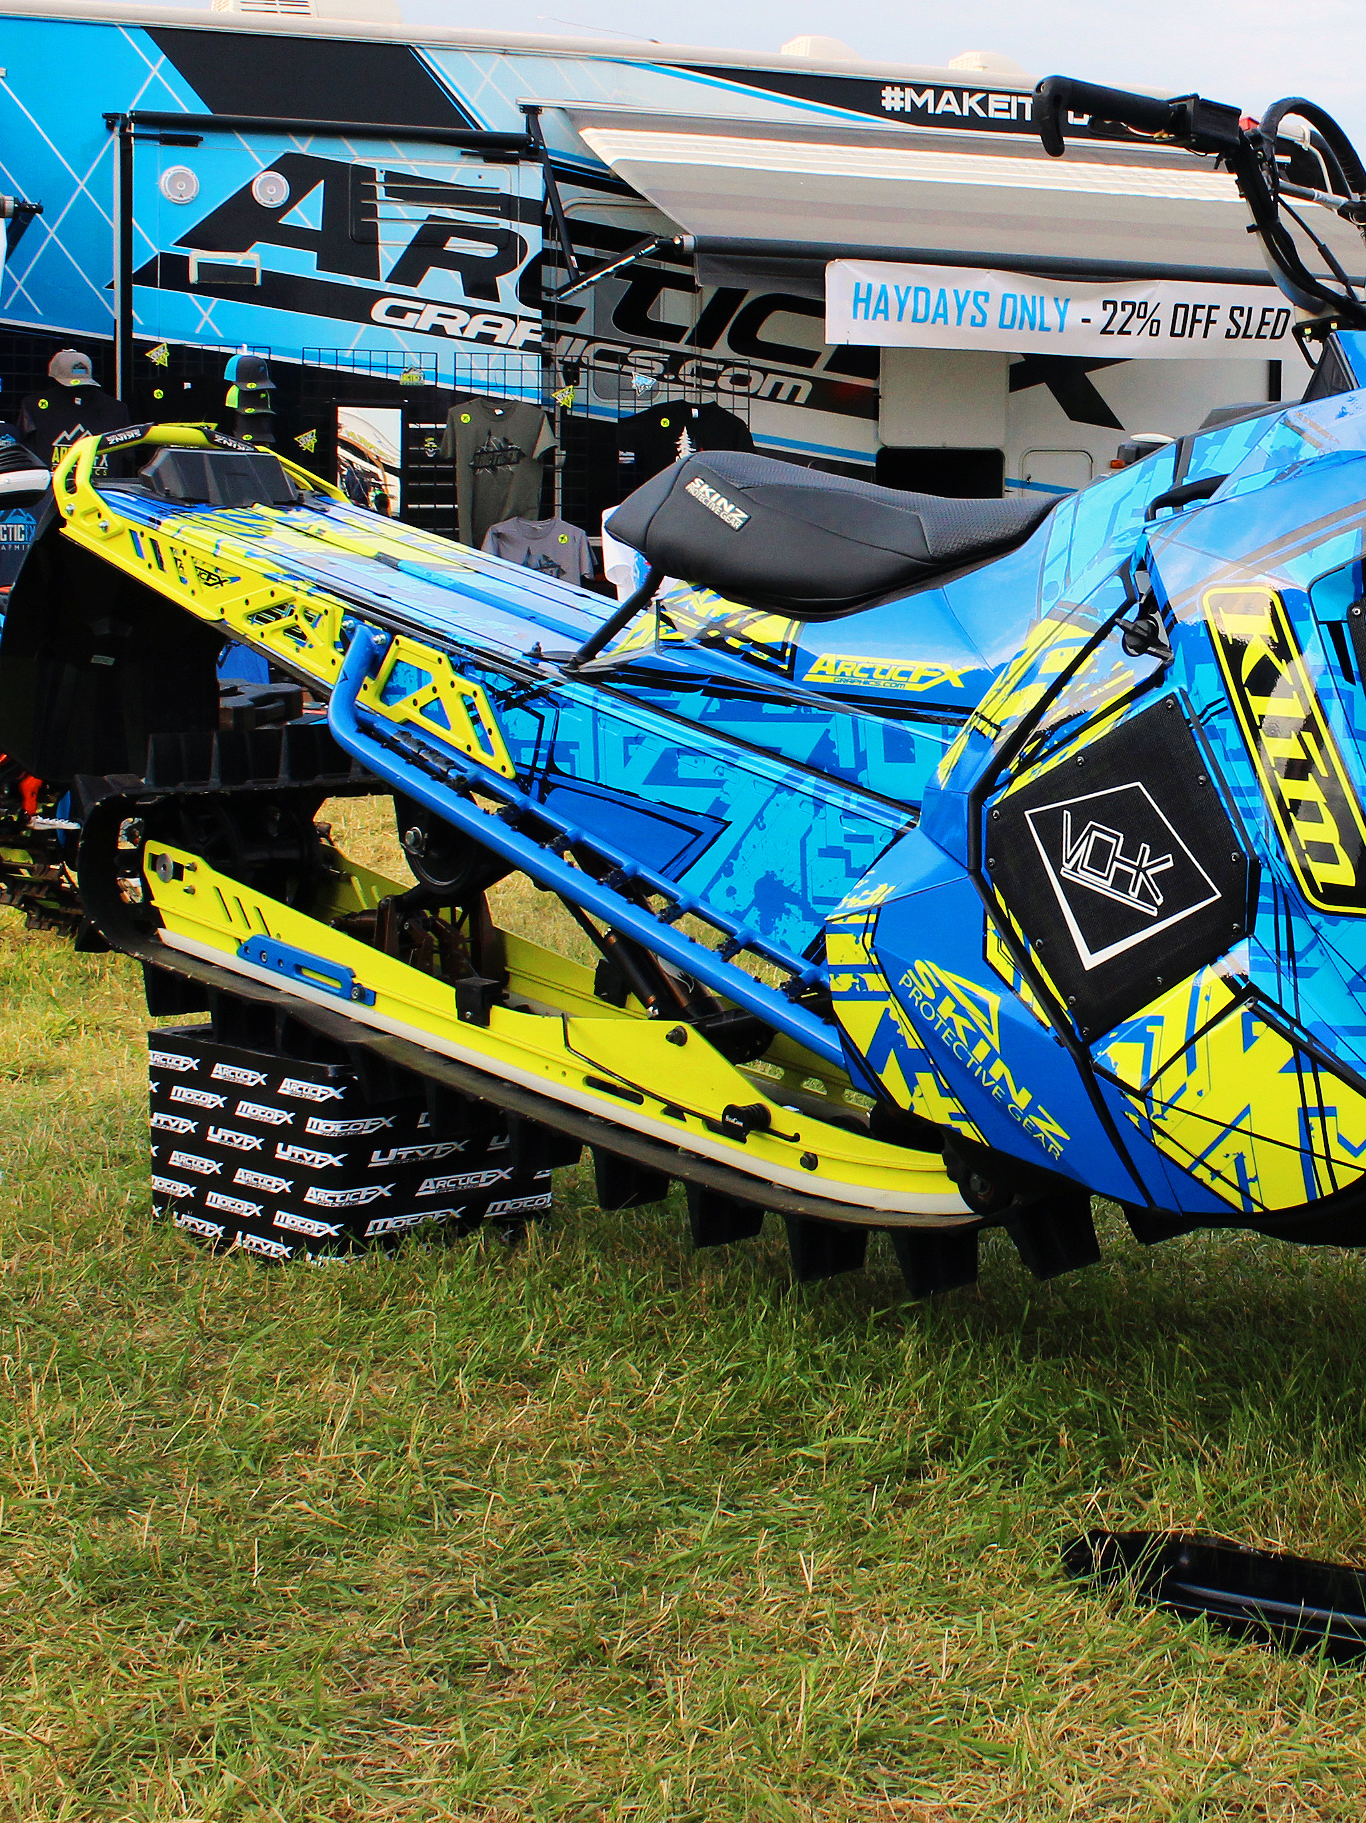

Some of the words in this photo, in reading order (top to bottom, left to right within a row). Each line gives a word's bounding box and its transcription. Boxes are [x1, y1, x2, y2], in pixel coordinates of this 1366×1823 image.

[852, 282, 990, 329] HAYDAYS
[999, 292, 1071, 332] ONLY
[1100, 299, 1161, 337] 22%
[1169, 303, 1221, 340] OFF
[1225, 306, 1292, 340] SLED
[686, 484, 722, 520] PROTECTIVE
[720, 509, 742, 531] GEAR
[691, 477, 749, 525] SKINZ
[899, 973, 1006, 1103] PROTECTIVE
[1008, 1103, 1064, 1161] GEAR
[907, 960, 1071, 1152] SKINZ
